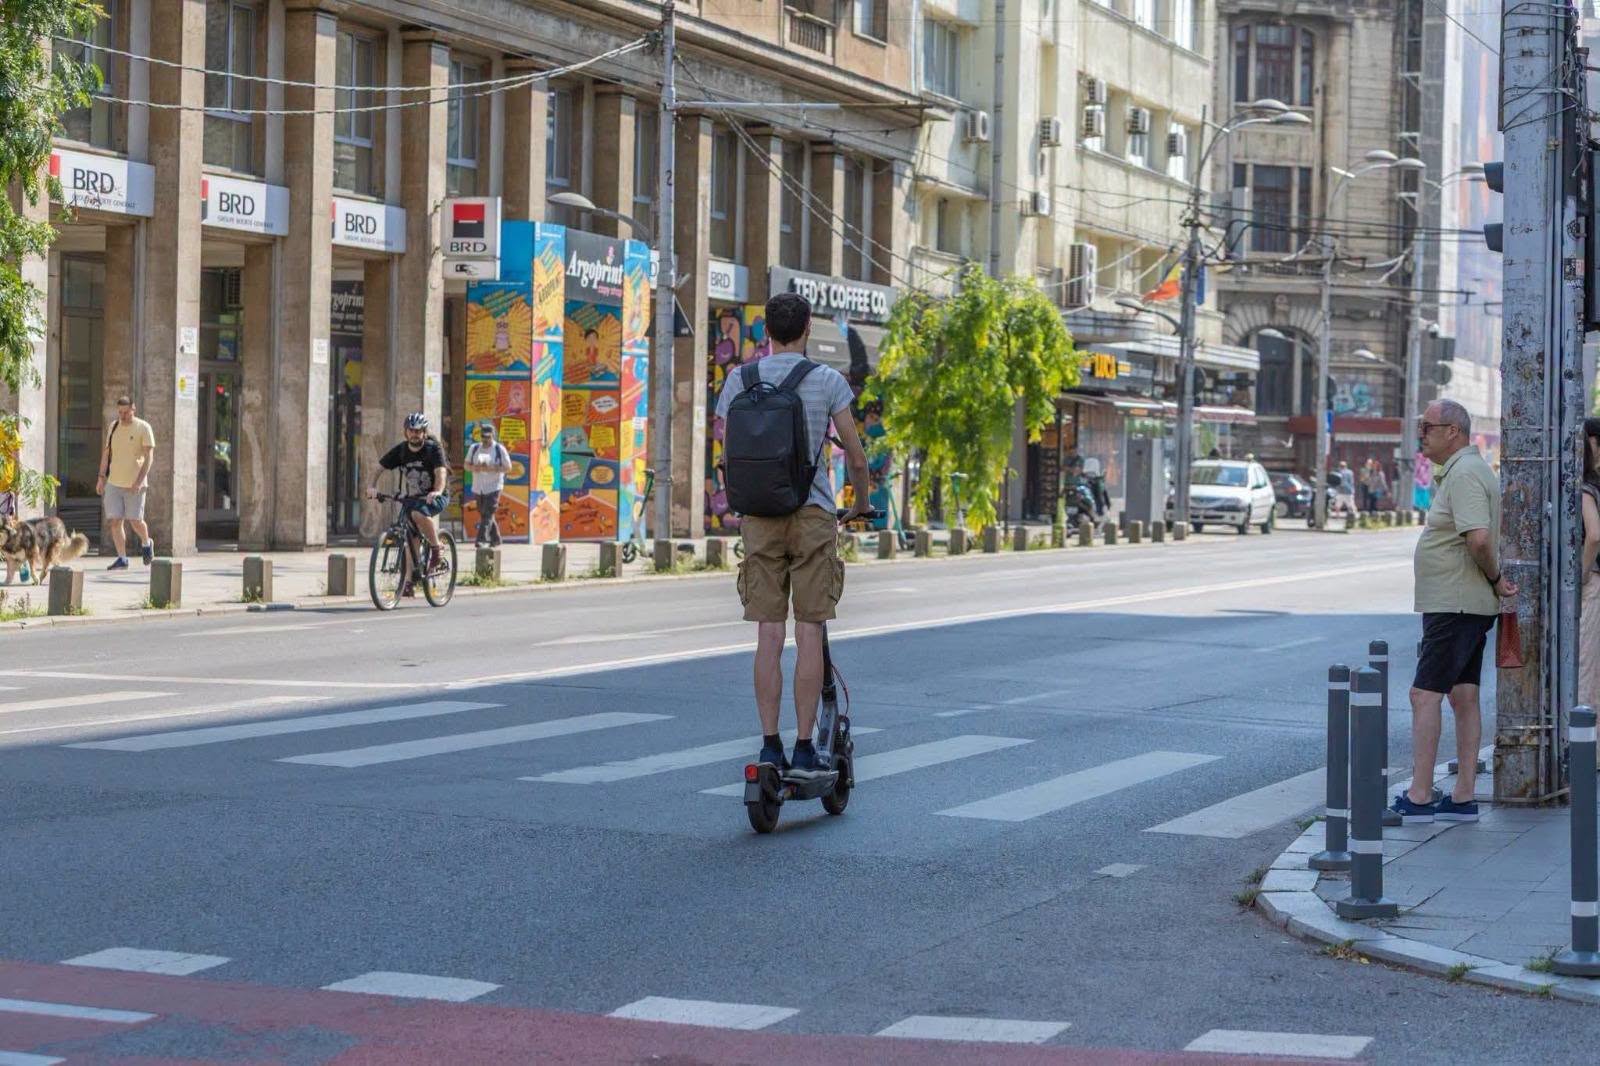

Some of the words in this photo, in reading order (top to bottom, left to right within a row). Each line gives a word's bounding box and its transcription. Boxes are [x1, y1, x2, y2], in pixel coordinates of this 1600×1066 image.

[73, 168, 114, 194] BRD
[666, 170, 672, 186] 2
[219, 192, 255, 215] BRD
[345, 213, 377, 234] BRD
[450, 242, 486, 253] BRD
[566, 250, 624, 289] Argoprint
[711, 272, 730, 289] BRD
[794, 277, 827, 306] TED'S
[829, 283, 864, 312] COFFEE
[871, 290, 889, 315] CO.
